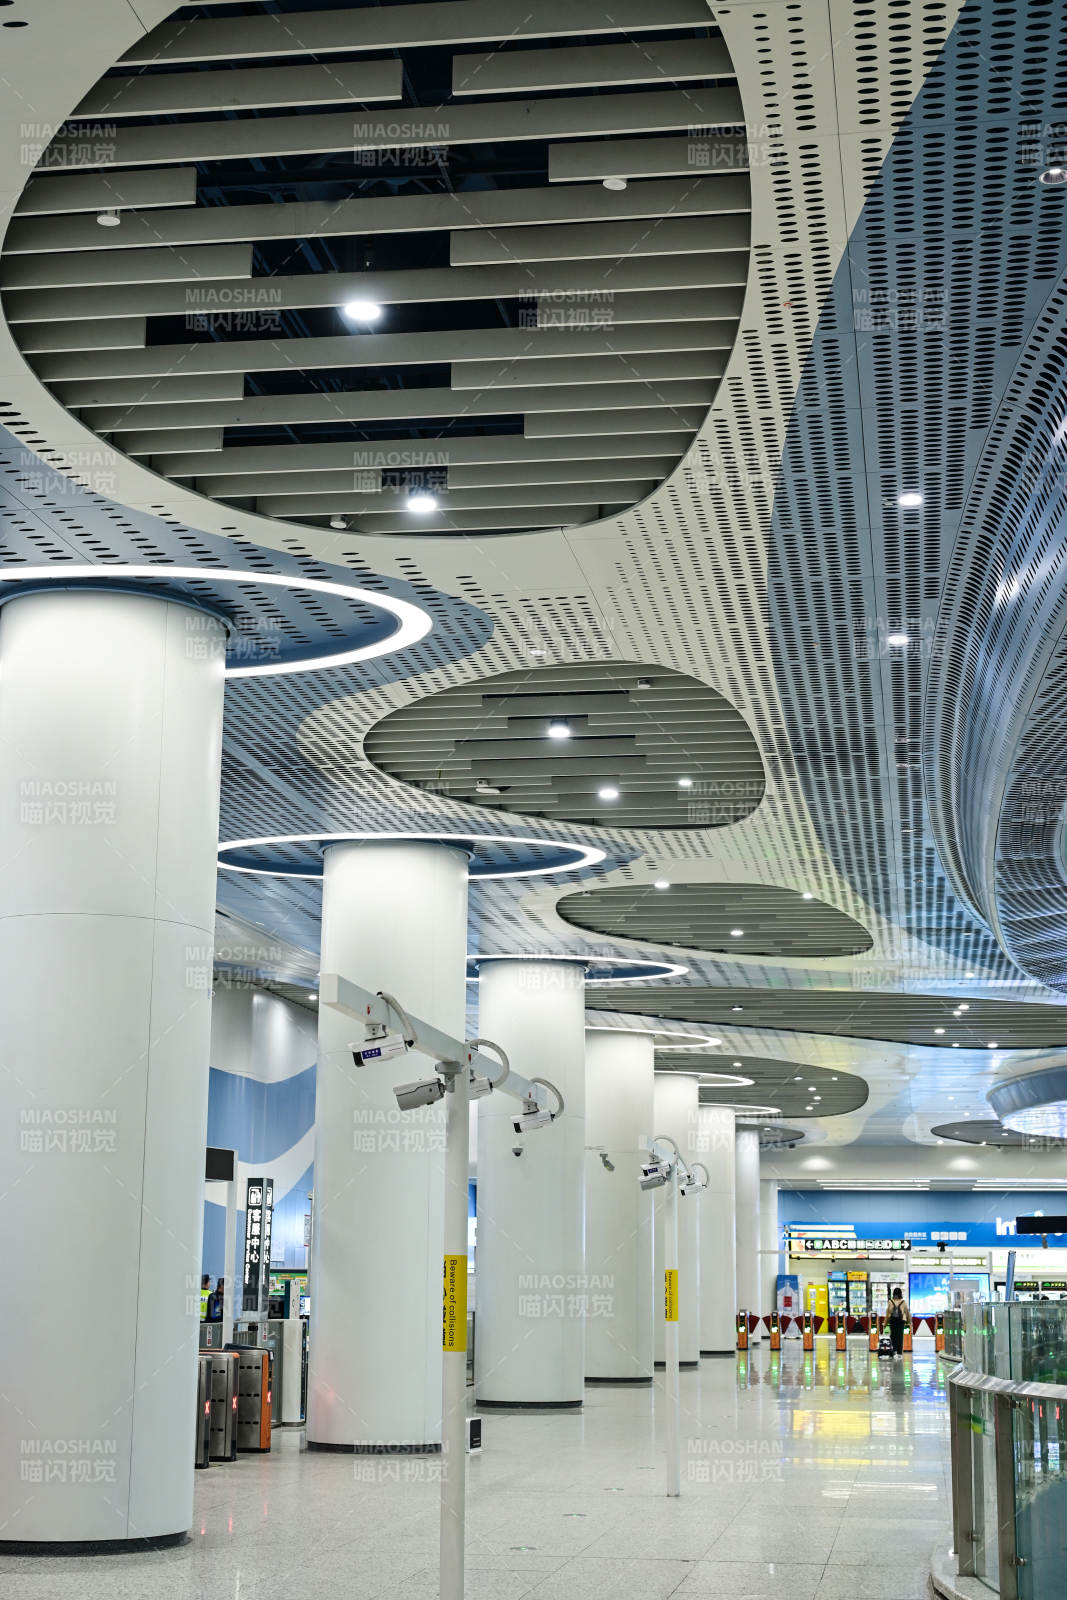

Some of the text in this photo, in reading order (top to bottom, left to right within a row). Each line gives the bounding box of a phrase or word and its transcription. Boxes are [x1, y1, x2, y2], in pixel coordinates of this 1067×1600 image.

[251, 1208, 261, 1263] 客服中心
[449, 1294, 456, 1304] of
[448, 1306, 456, 1347] collisions
